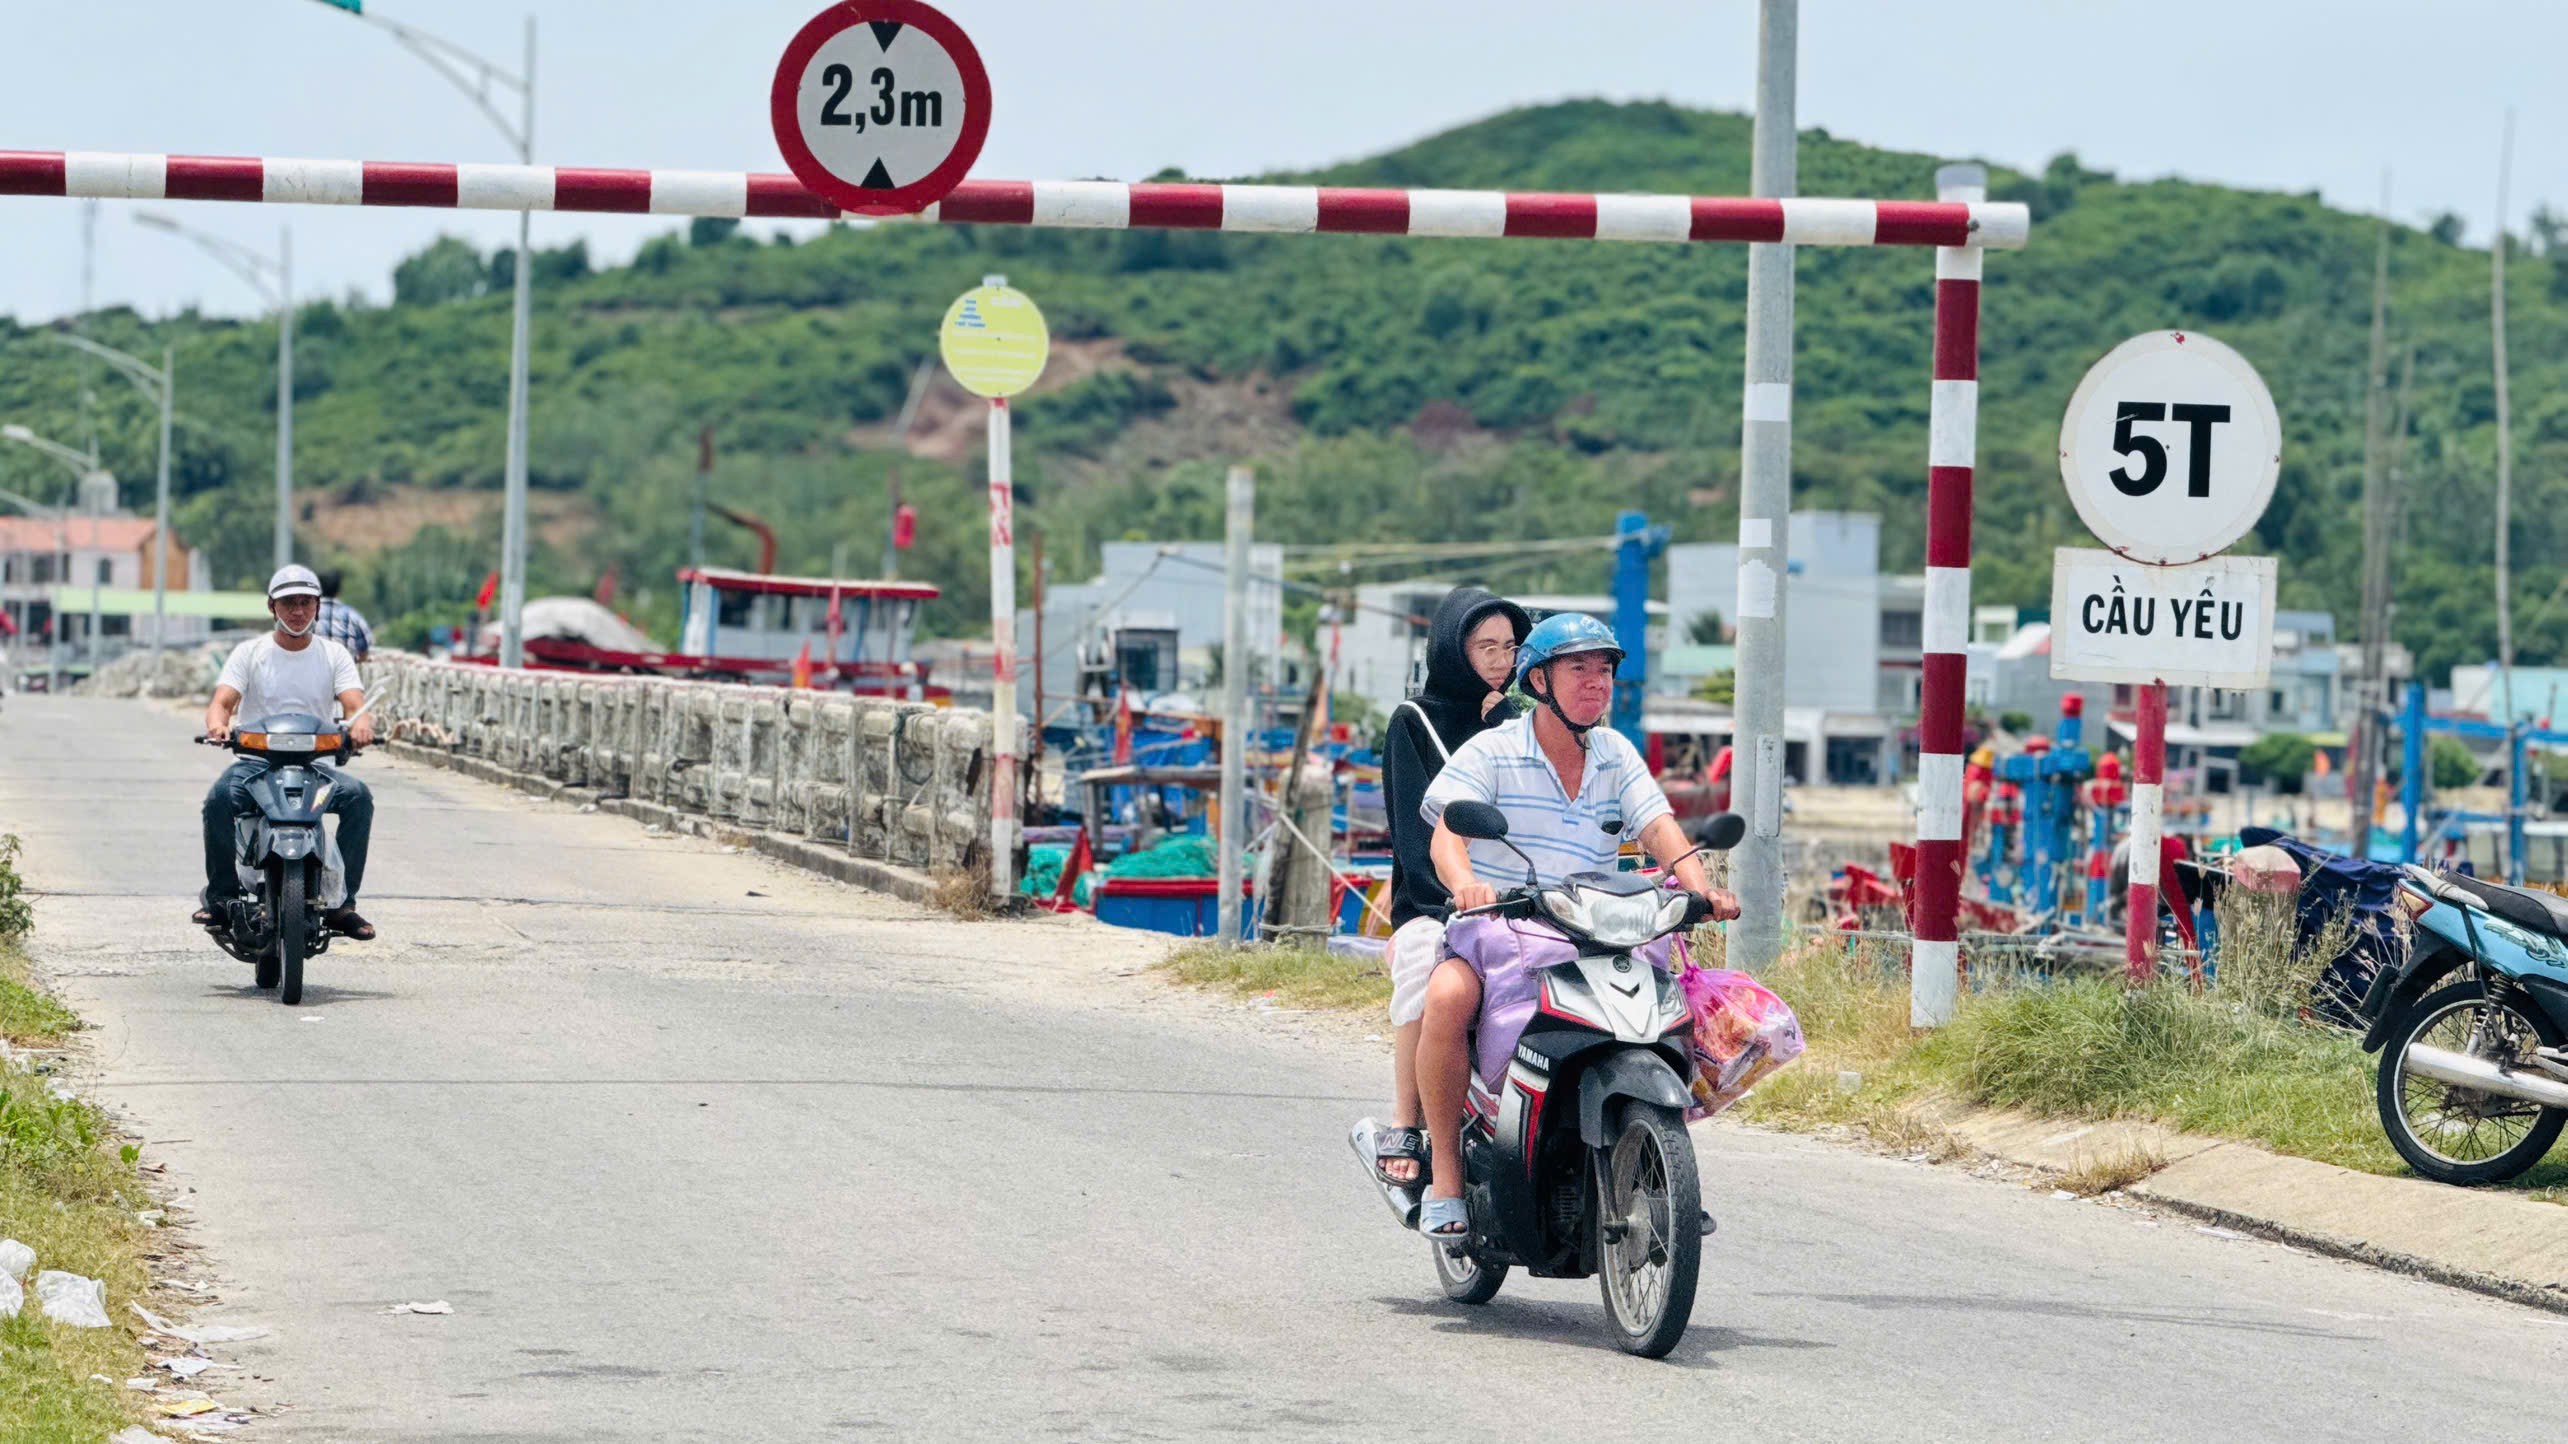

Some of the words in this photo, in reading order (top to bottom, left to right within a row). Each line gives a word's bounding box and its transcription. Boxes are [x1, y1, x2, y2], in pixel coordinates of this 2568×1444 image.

[820, 63, 942, 134] 2,3m
[2109, 401, 2231, 498] 5T
[2082, 574, 2155, 636] CẦU
[1517, 1043, 1550, 1072] YAMAHA
